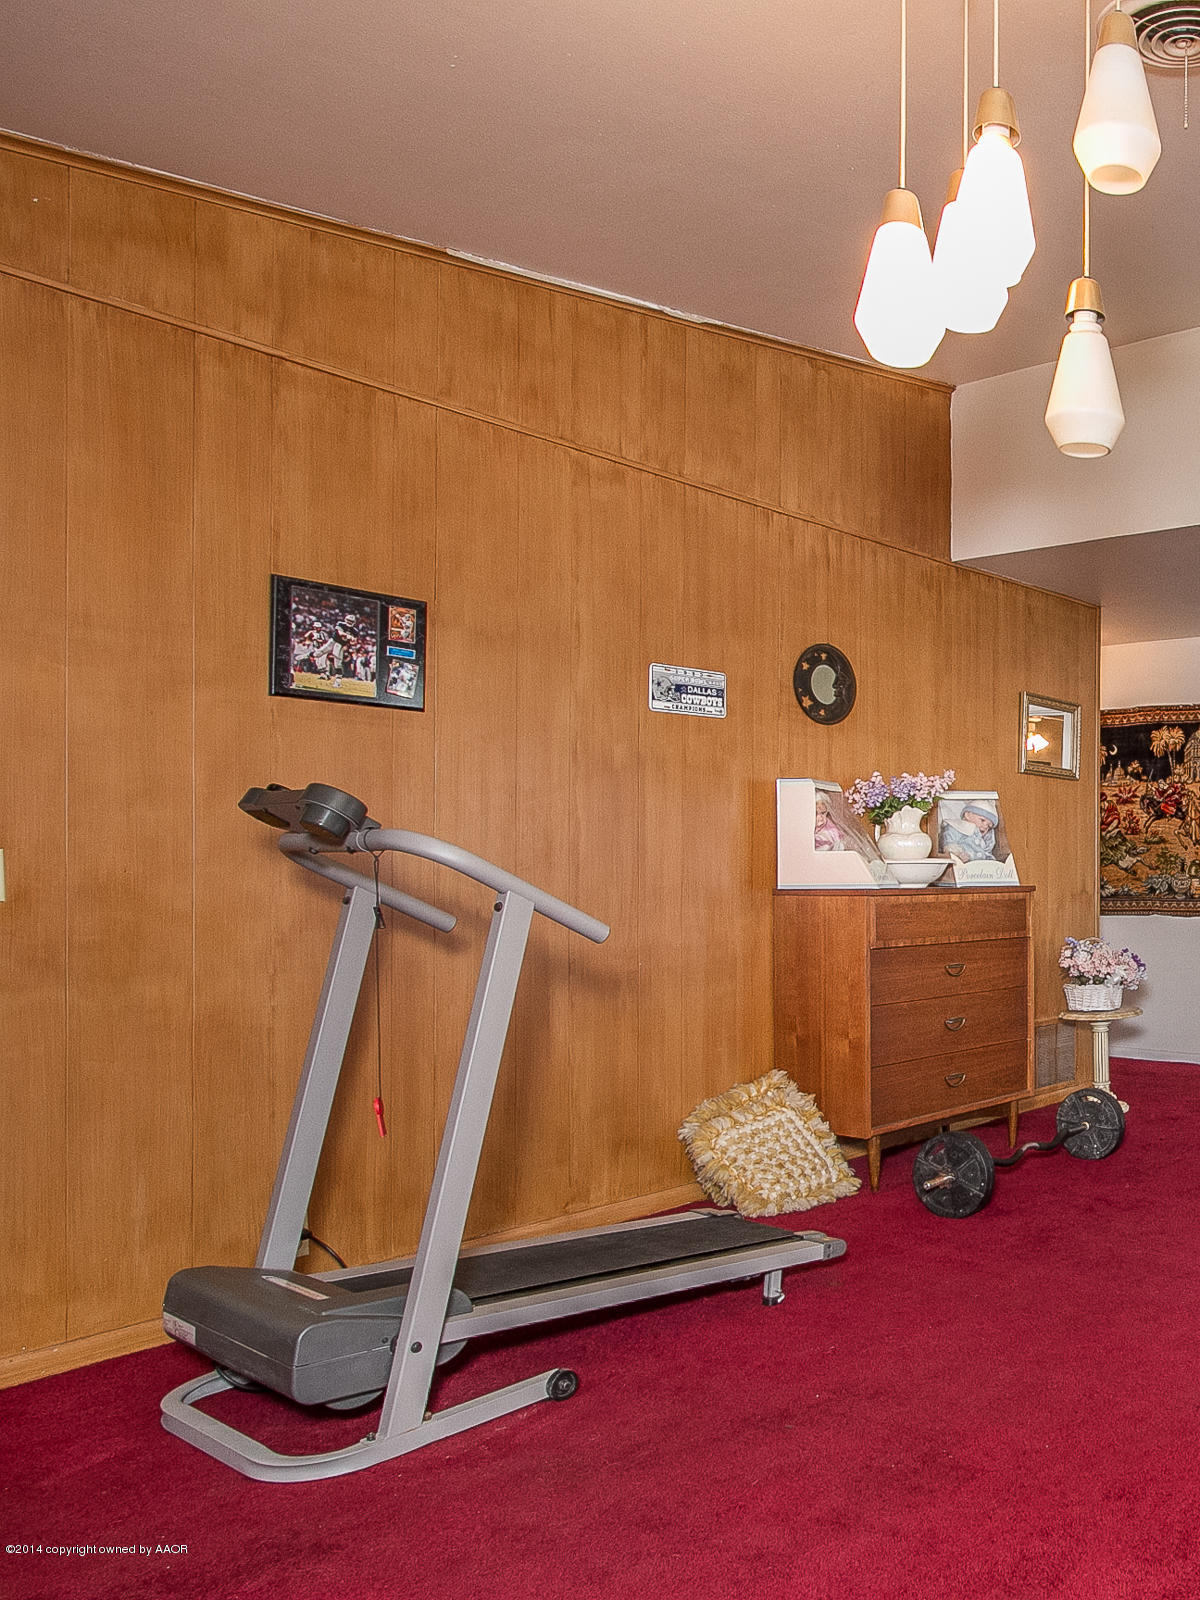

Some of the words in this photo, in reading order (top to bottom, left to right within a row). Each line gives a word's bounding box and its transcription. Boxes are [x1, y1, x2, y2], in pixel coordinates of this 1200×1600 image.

[687, 686, 717, 695] DALLAS
[681, 694, 723, 707] COWBOYS
[671, 703, 706, 712] CHAMPIONS
[959, 868, 994, 880] Porcelain
[995, 865, 1014, 880] Doll
